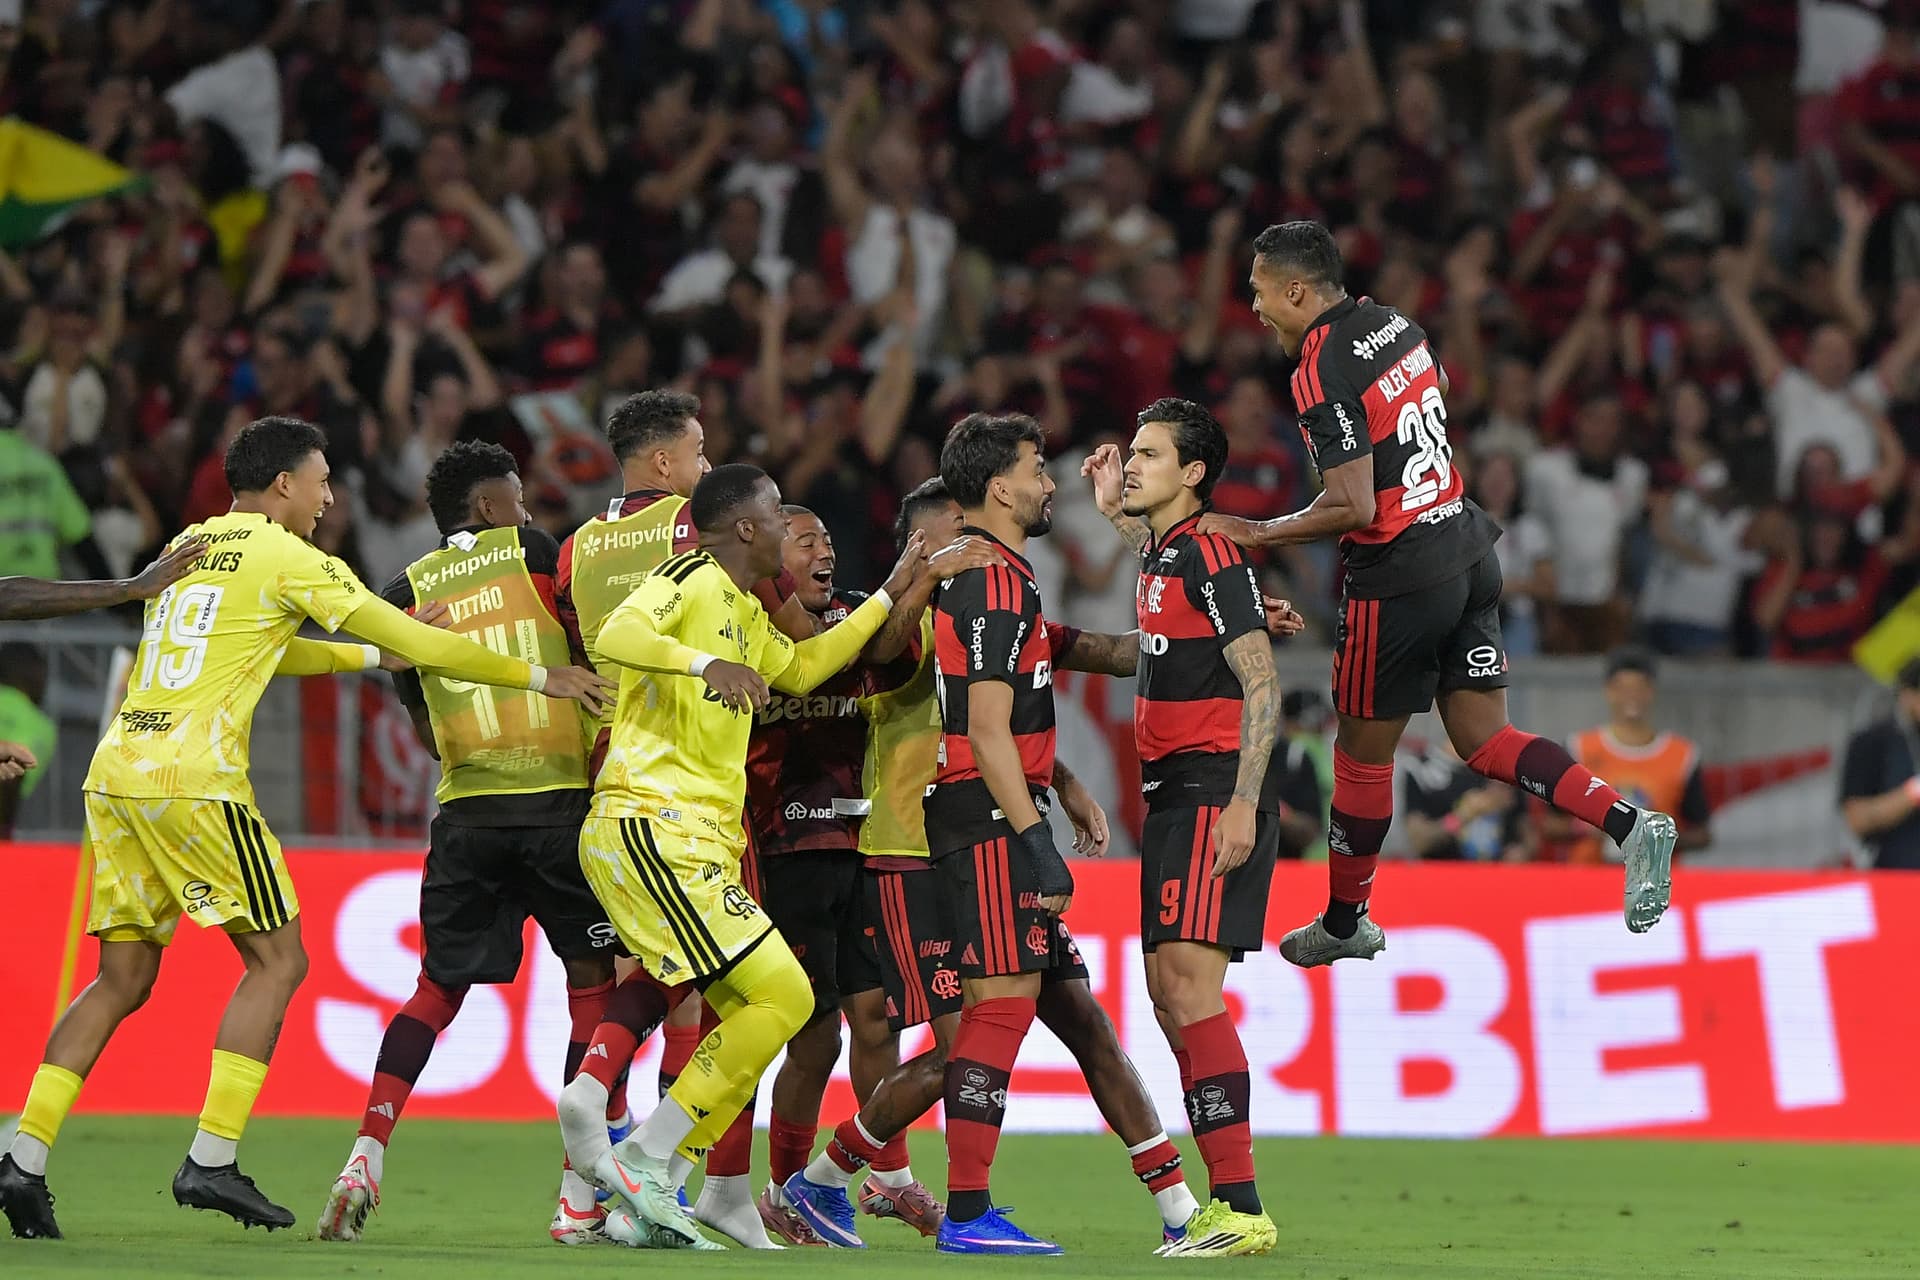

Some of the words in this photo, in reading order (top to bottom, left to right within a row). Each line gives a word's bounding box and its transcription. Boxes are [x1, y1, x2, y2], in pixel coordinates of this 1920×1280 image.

[1378, 365, 1412, 404] ALEX
[1333, 402, 1357, 451] Shopee
[198, 528, 253, 545] pvida
[604, 523, 689, 551] Hapvida
[441, 545, 526, 583] Hapvida
[201, 592, 216, 620] TEXACO
[448, 586, 504, 624] VITÃO
[1200, 581, 1225, 635] Shopee
[972, 616, 986, 671] Shopee
[187, 895, 220, 914] GAC
[1159, 879, 1181, 925] 9
[919, 940, 952, 958] Wap
[1204, 1101, 1235, 1117] Zé
